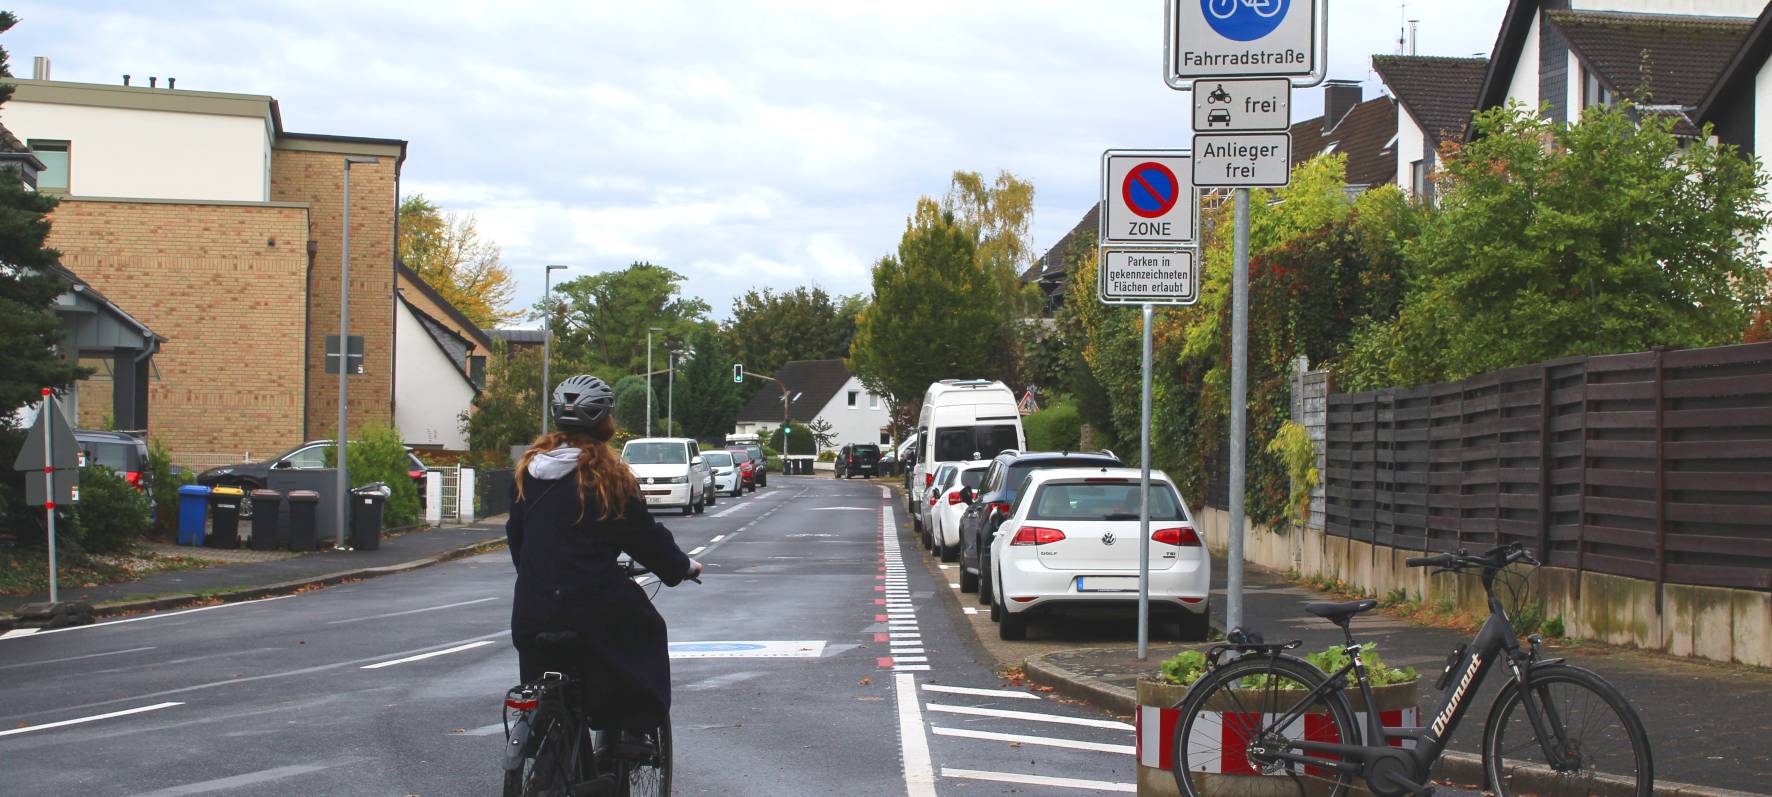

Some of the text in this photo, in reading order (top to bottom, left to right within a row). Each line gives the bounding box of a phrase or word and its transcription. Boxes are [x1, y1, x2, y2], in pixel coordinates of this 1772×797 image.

[1184, 49, 1305, 66] Fahrradstraße
[1244, 97, 1277, 113] frei
[1203, 142, 1278, 161] Anlieger
[1226, 163, 1255, 178] frei
[1128, 222, 1171, 236] ZONE
[1127, 256, 1170, 267] Parken in
[1110, 269, 1188, 281] gekennzeichneten
[1114, 282, 1183, 293] Flächen erlaubt
[1431, 653, 1482, 737] Diamant
